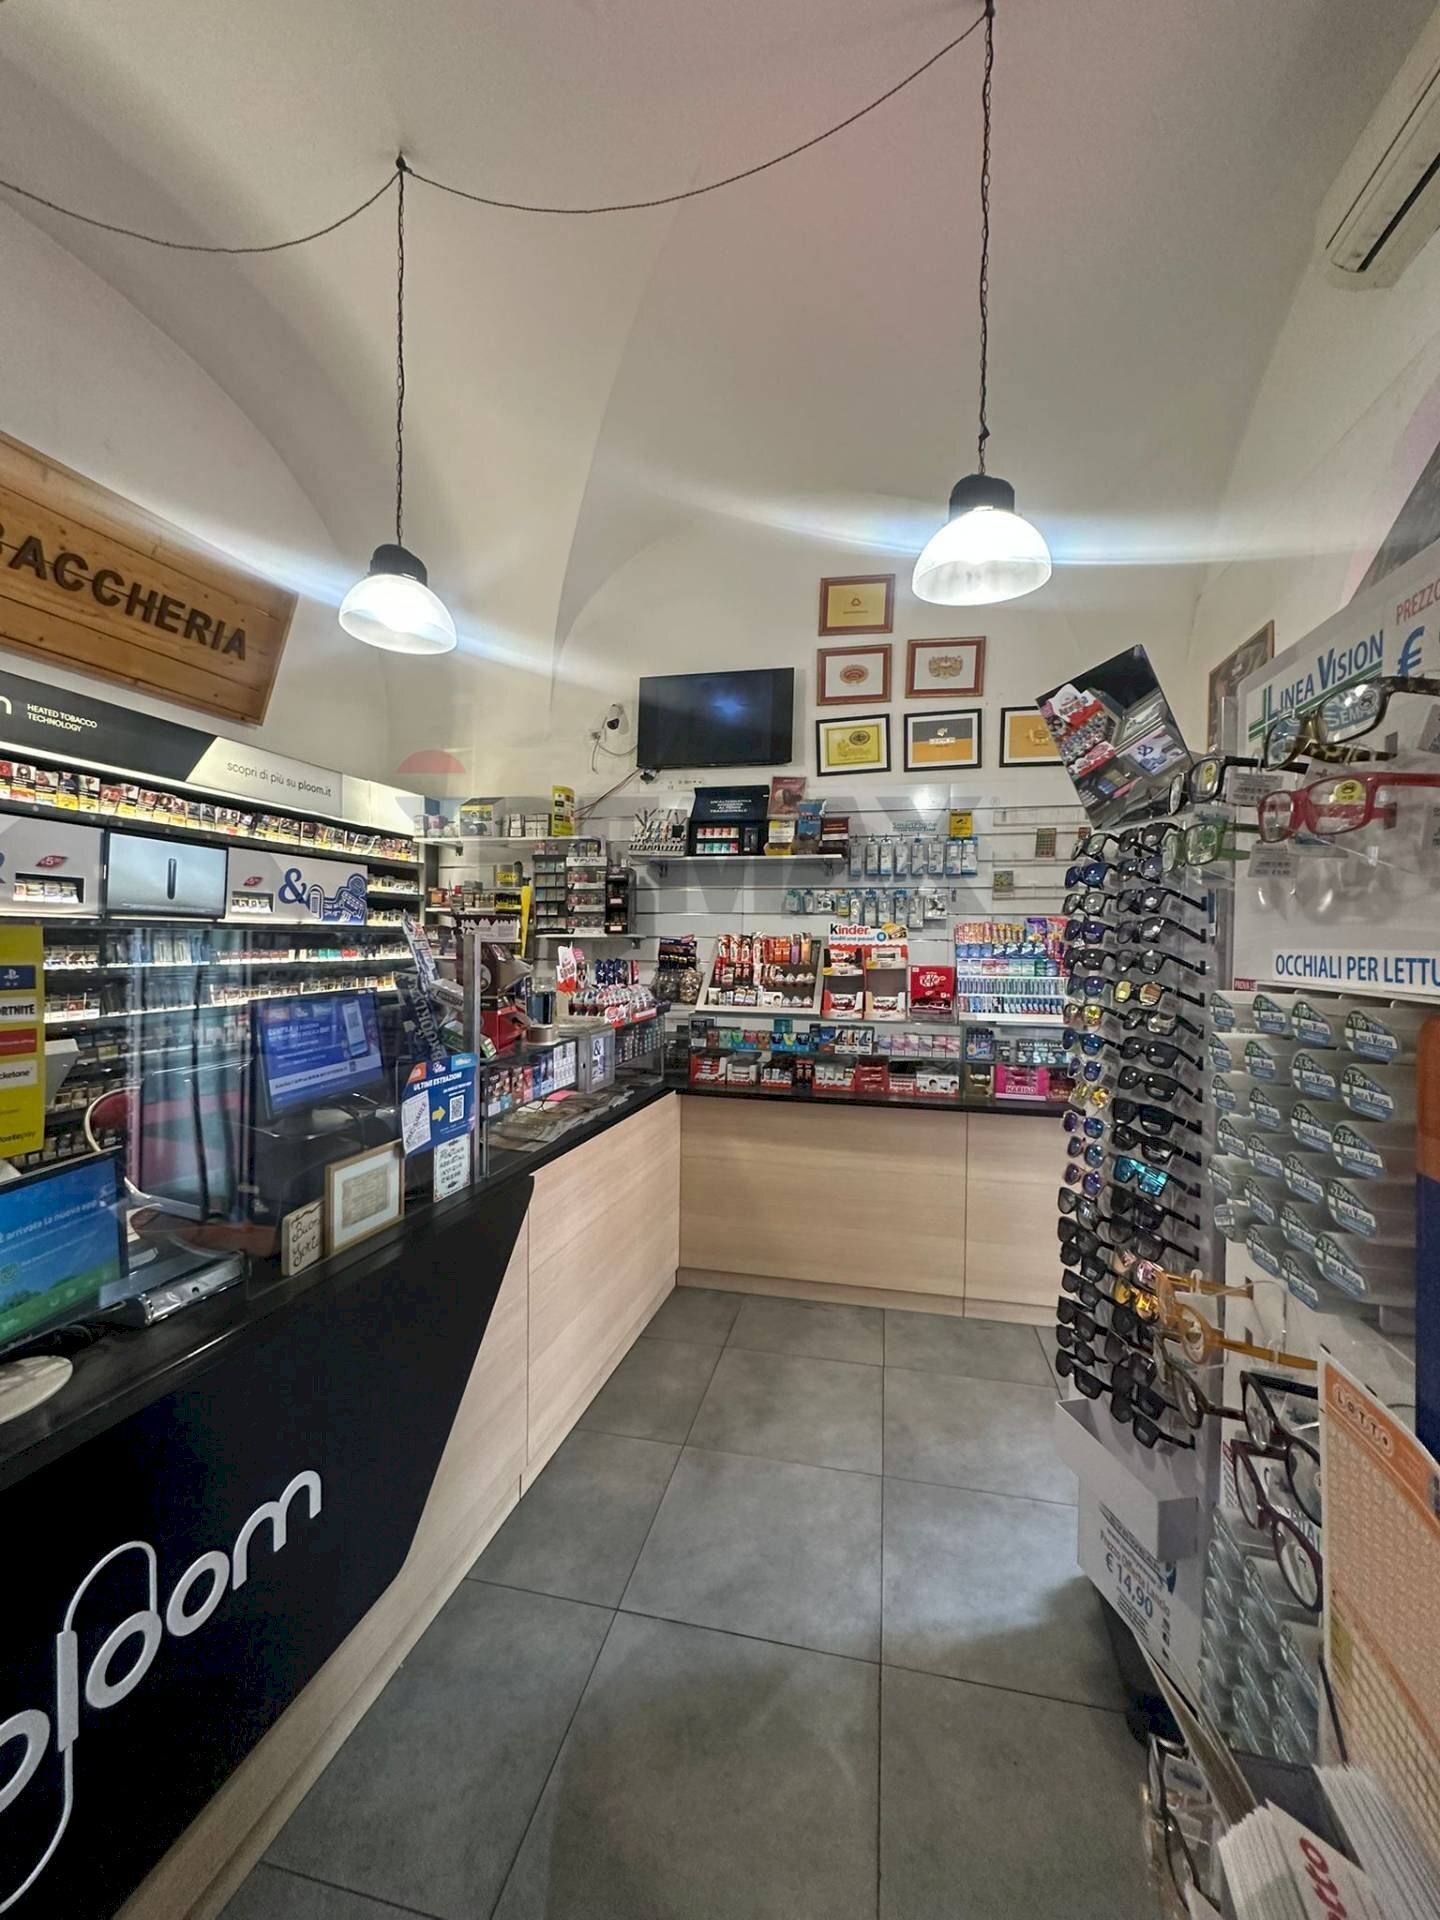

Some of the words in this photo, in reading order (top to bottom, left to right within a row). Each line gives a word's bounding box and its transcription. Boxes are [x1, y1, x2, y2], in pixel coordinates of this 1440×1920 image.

[1268, 673, 1315, 720] LINEA
[1318, 629, 1383, 690] VISION
[27, 703, 58, 718] HEATED
[60, 711, 98, 729] TOBACCO
[27, 712, 83, 733] TECHNOLOGY
[226, 762, 256, 778] scopri
[258, 768, 269, 780] di
[286, 777, 297, 787] su
[298, 779, 332, 797] ploom.it
[830, 924, 869, 935] Kinder
[1275, 954, 1342, 979] OCCHIALI
[1347, 956, 1378, 981] PER
[1336, 1388, 1391, 1450] LOTTO
[1105, 1552, 1113, 1574] €
[1116, 1562, 1154, 1619] 14,90
